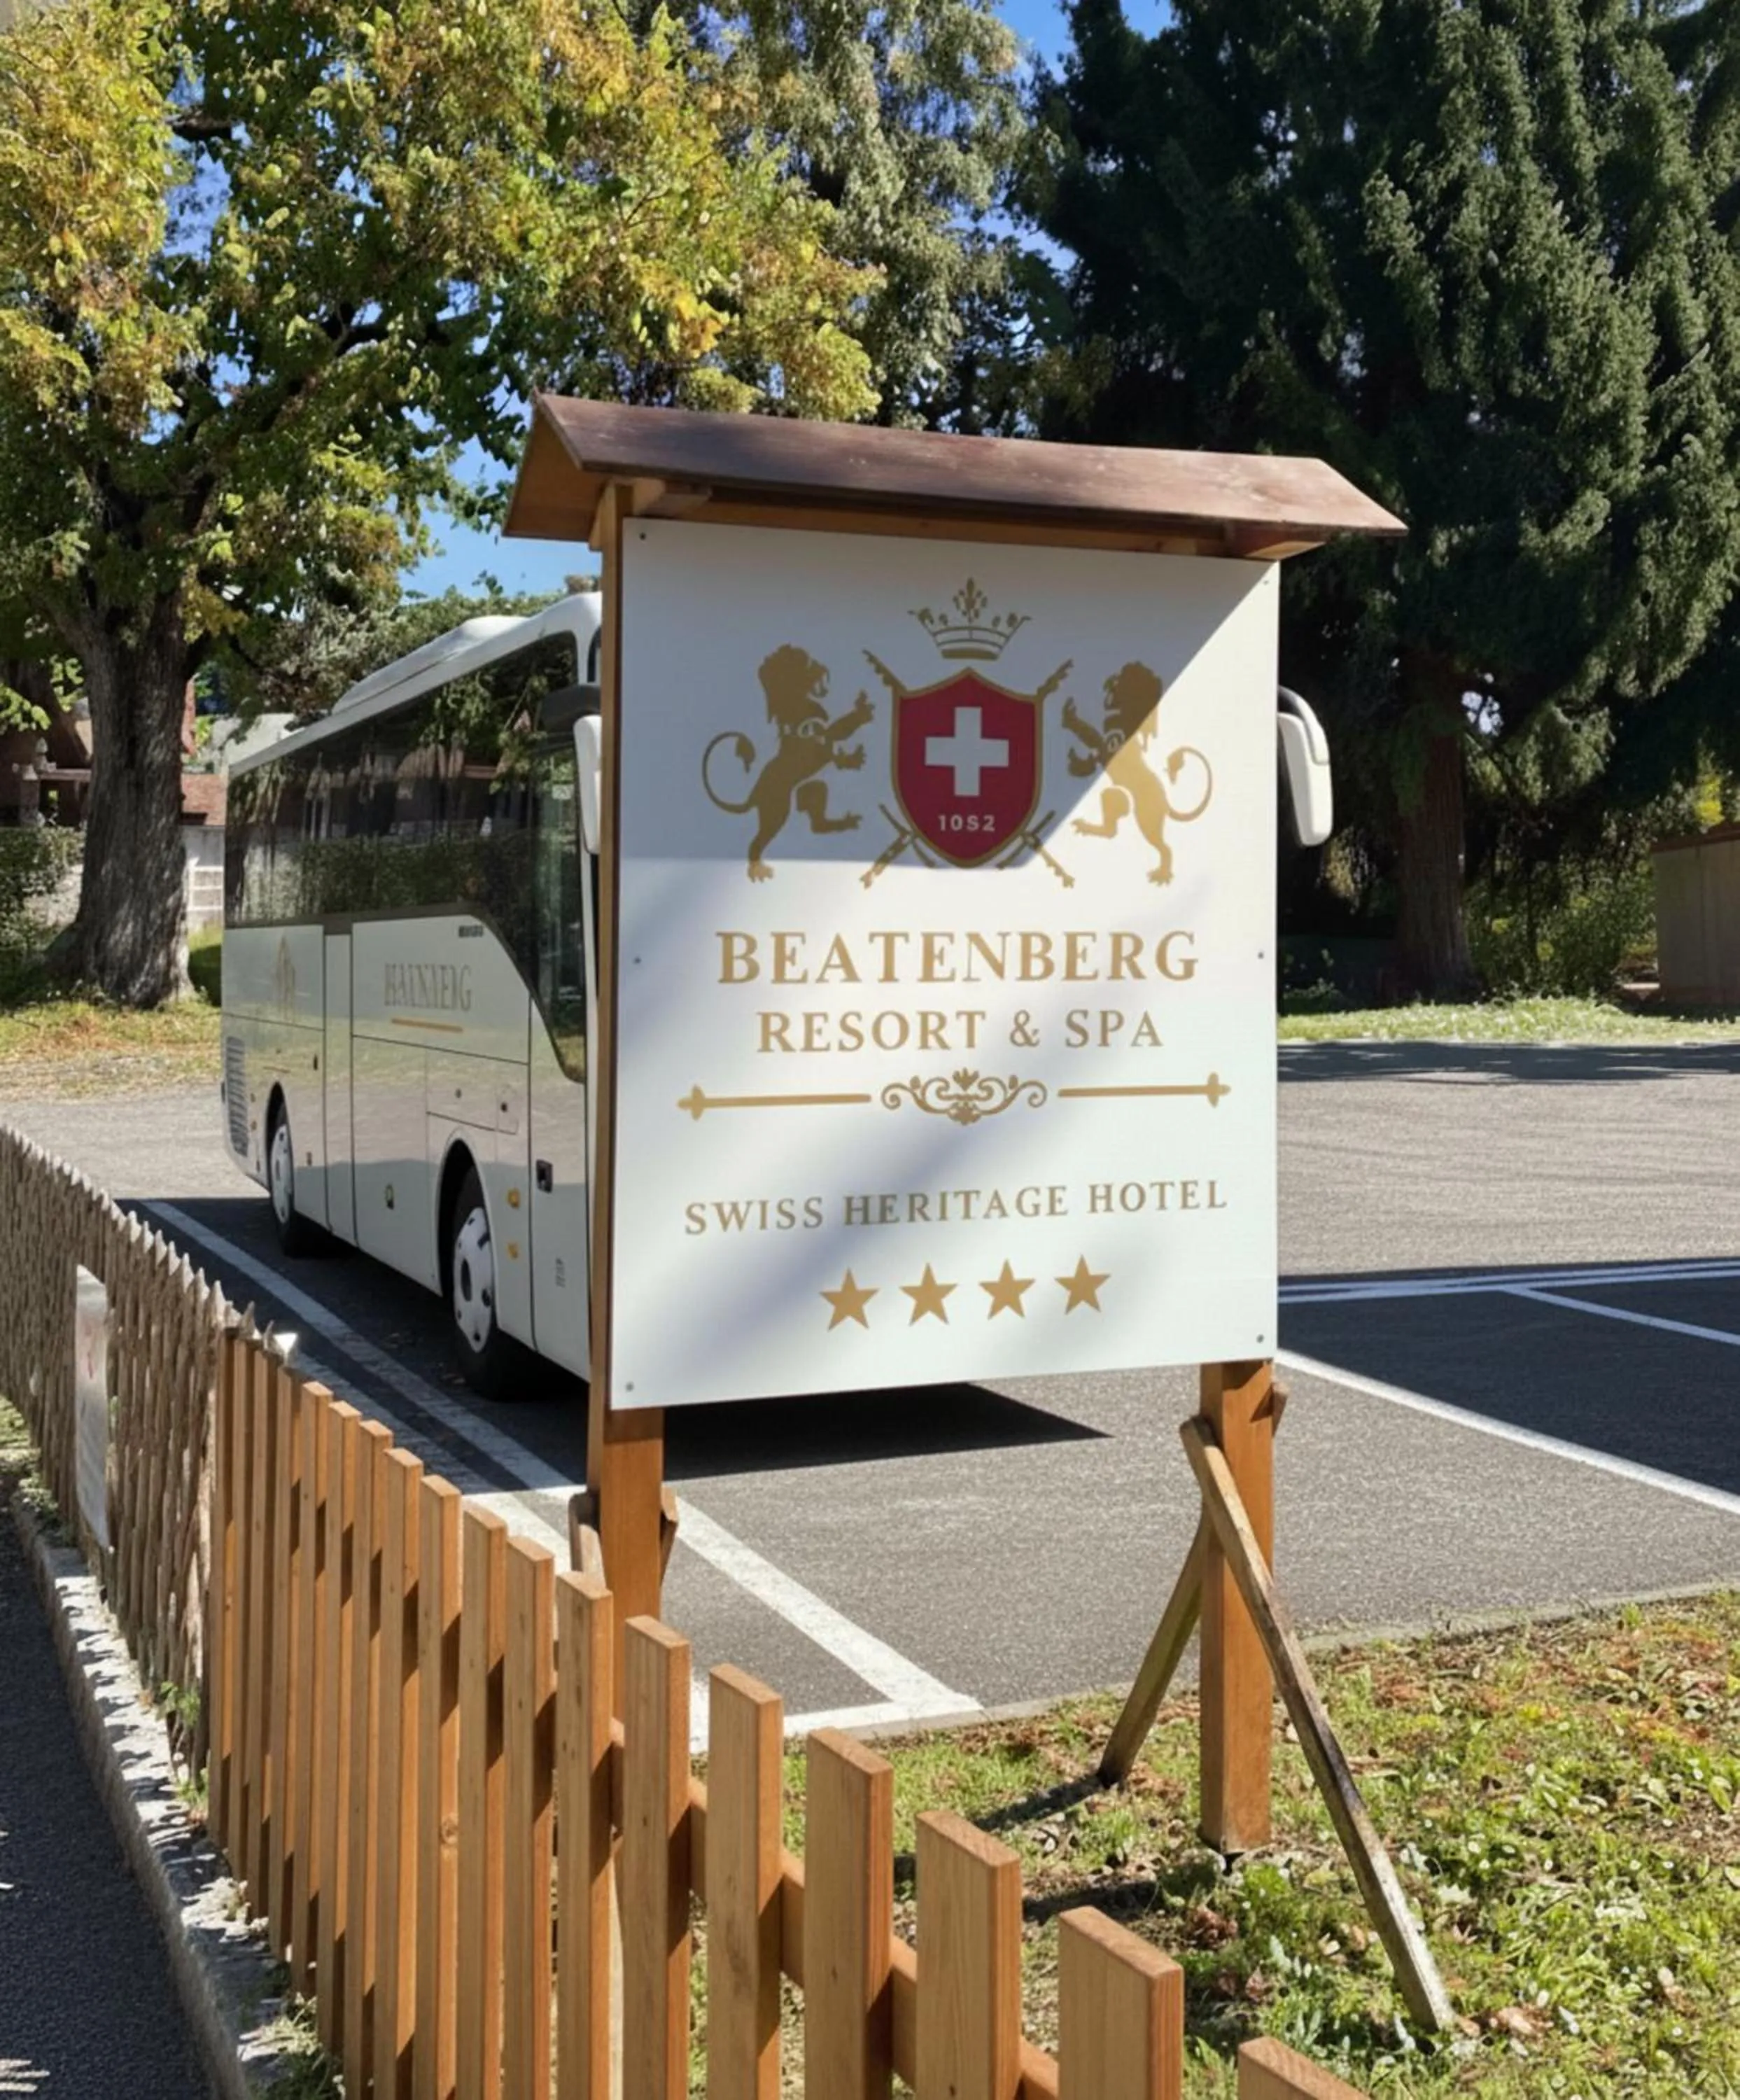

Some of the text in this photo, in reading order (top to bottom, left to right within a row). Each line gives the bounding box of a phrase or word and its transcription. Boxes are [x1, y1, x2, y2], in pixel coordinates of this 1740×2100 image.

[715, 930, 1198, 984] BEATENBERG
[757, 1009, 1164, 1054] RESORT & SPA
[684, 1179, 1228, 1236] SWISS HERITAGE HOTEL
